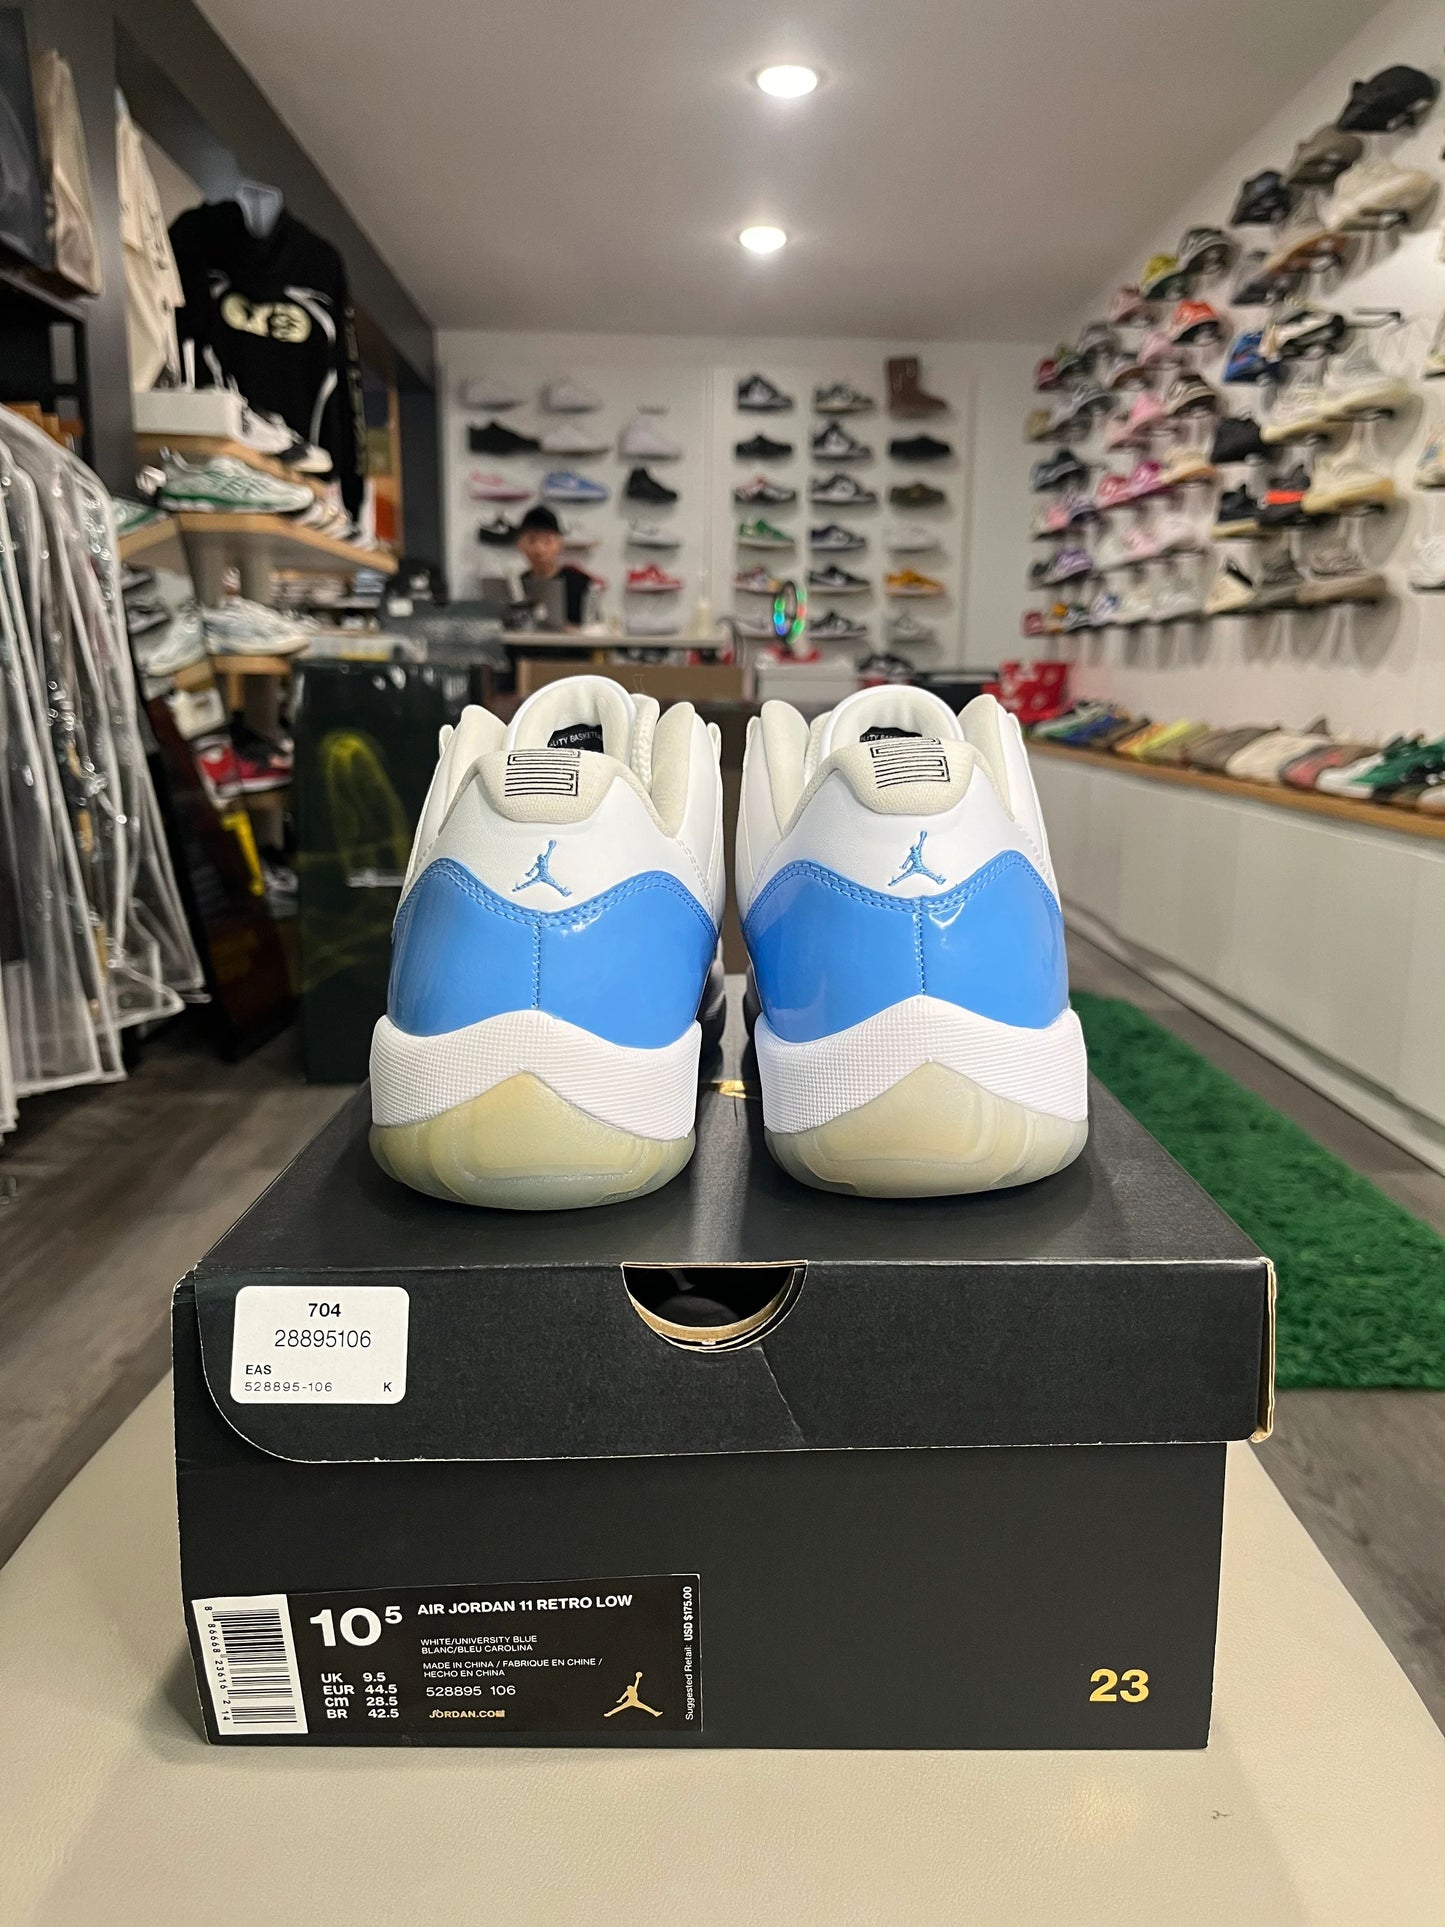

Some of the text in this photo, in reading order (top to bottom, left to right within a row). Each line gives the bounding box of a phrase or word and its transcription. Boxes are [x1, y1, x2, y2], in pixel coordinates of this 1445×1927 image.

[308, 1302, 341, 1318] 704
[274, 1329, 372, 1348] 28895106
[245, 1364, 272, 1375] EAS
[244, 1381, 392, 1392] 528895-106 K
[417, 1594, 633, 1615] AIR JORDAN 11 RETRO LOW
[420, 1634, 538, 1646] WHITE/UNIVERSITY BLUE
[421, 1644, 533, 1655] BLANC/BLEU CAROLINA
[682, 1586, 696, 1720] Suggested Retail: USD $175.00
[423, 1661, 451, 1670] MADE
[453, 1661, 463, 1669] IN
[464, 1660, 494, 1669] CHINA
[502, 1659, 549, 1668] FABRIQUE
[551, 1658, 565, 1667] EN
[567, 1657, 596, 1666] CHINE
[321, 1671, 386, 1684] UK 9.5
[424, 1669, 505, 1678] HECHO EN CHINA
[323, 1683, 398, 1695] EUR 44.5
[426, 1685, 516, 1697] 528895 106
[1089, 1668, 1150, 1703] 23
[324, 1696, 398, 1707] cm 28.5
[326, 1708, 400, 1719] BR 42.5
